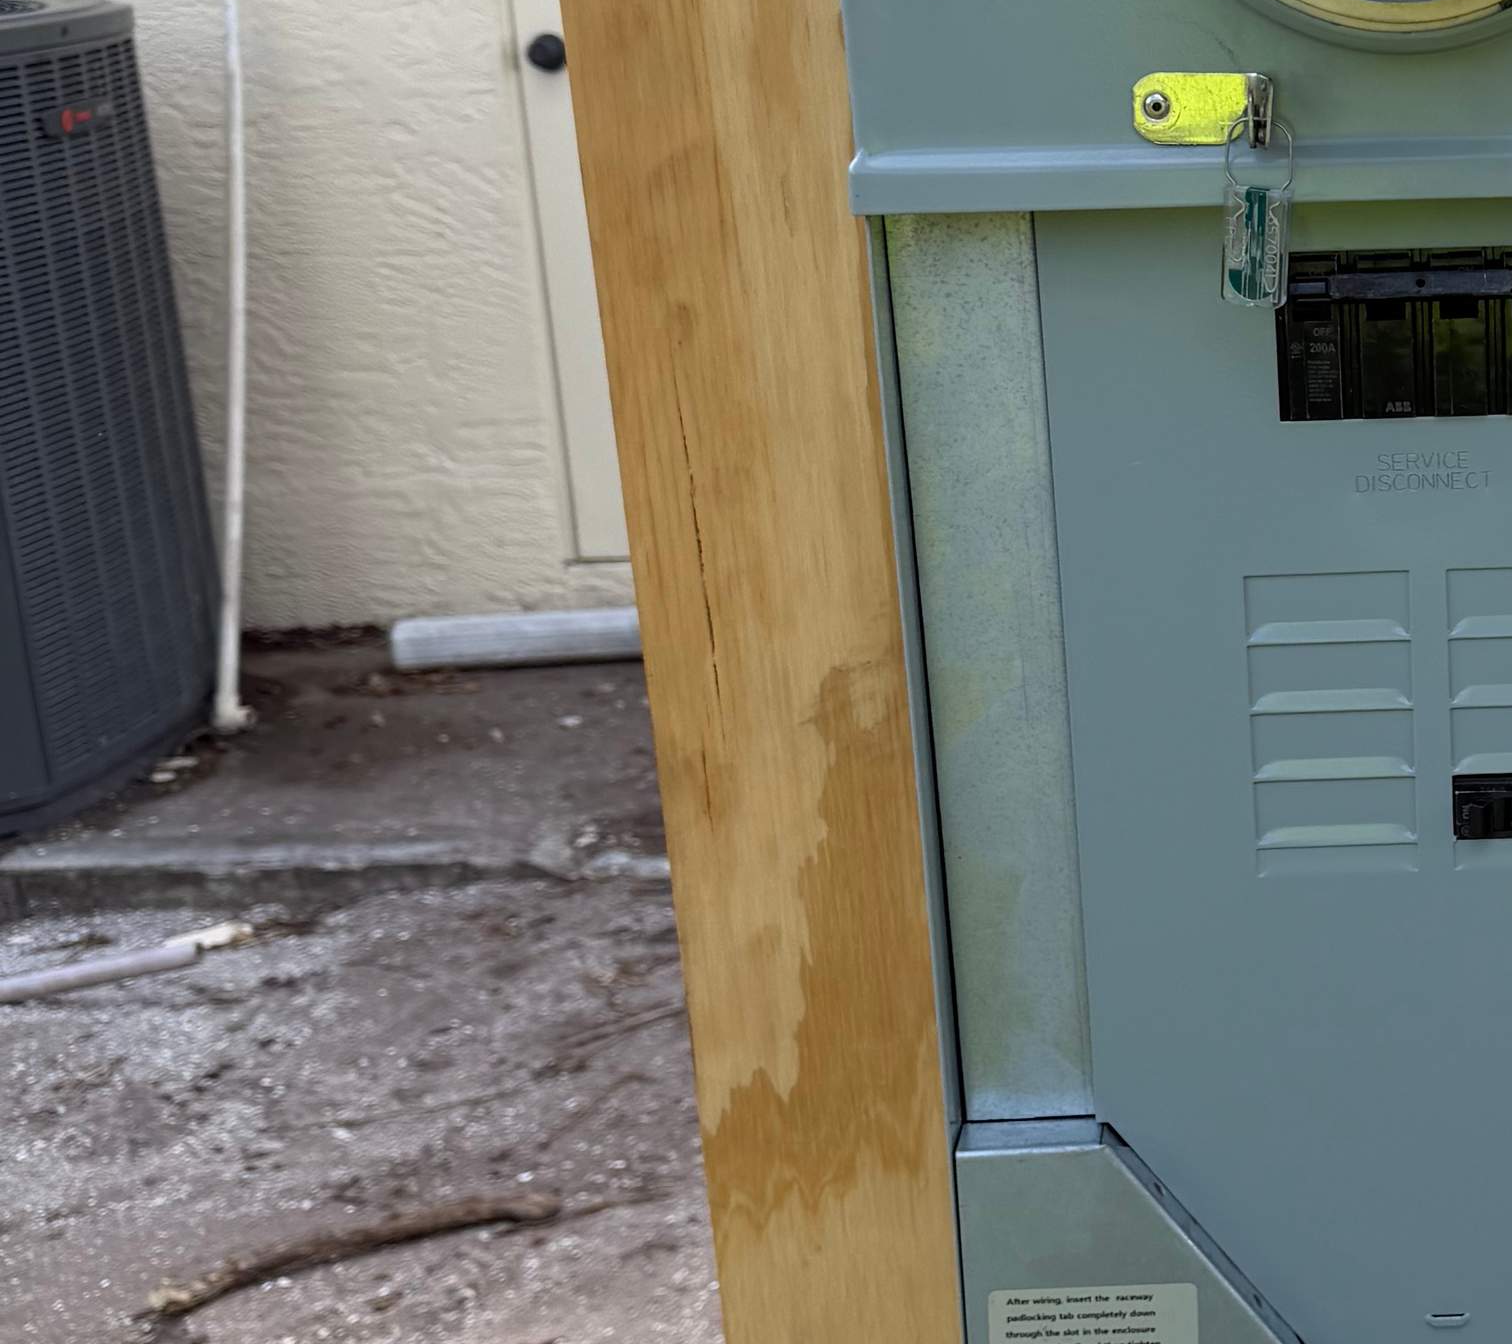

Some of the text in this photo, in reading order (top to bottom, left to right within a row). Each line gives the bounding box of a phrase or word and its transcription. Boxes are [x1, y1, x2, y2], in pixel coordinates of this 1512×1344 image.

[1313, 327, 1332, 337] OFF
[1309, 342, 1336, 353] 200A
[1376, 450, 1470, 472] SERVICE
[1354, 470, 1492, 494] DISCONNECT
[1006, 1298, 1029, 1306] After
[1066, 1295, 1091, 1303] insert
[1095, 1294, 1109, 1302] the
[1116, 1294, 1154, 1302] raceway
[1007, 1309, 1156, 1323] padlocking tab completely down
[1006, 1330, 1042, 1339] through
[1045, 1329, 1060, 1337] the
[1063, 1328, 1079, 1336] slot
[1094, 1327, 1109, 1335] the
[1112, 1326, 1156, 1334] enclosure
